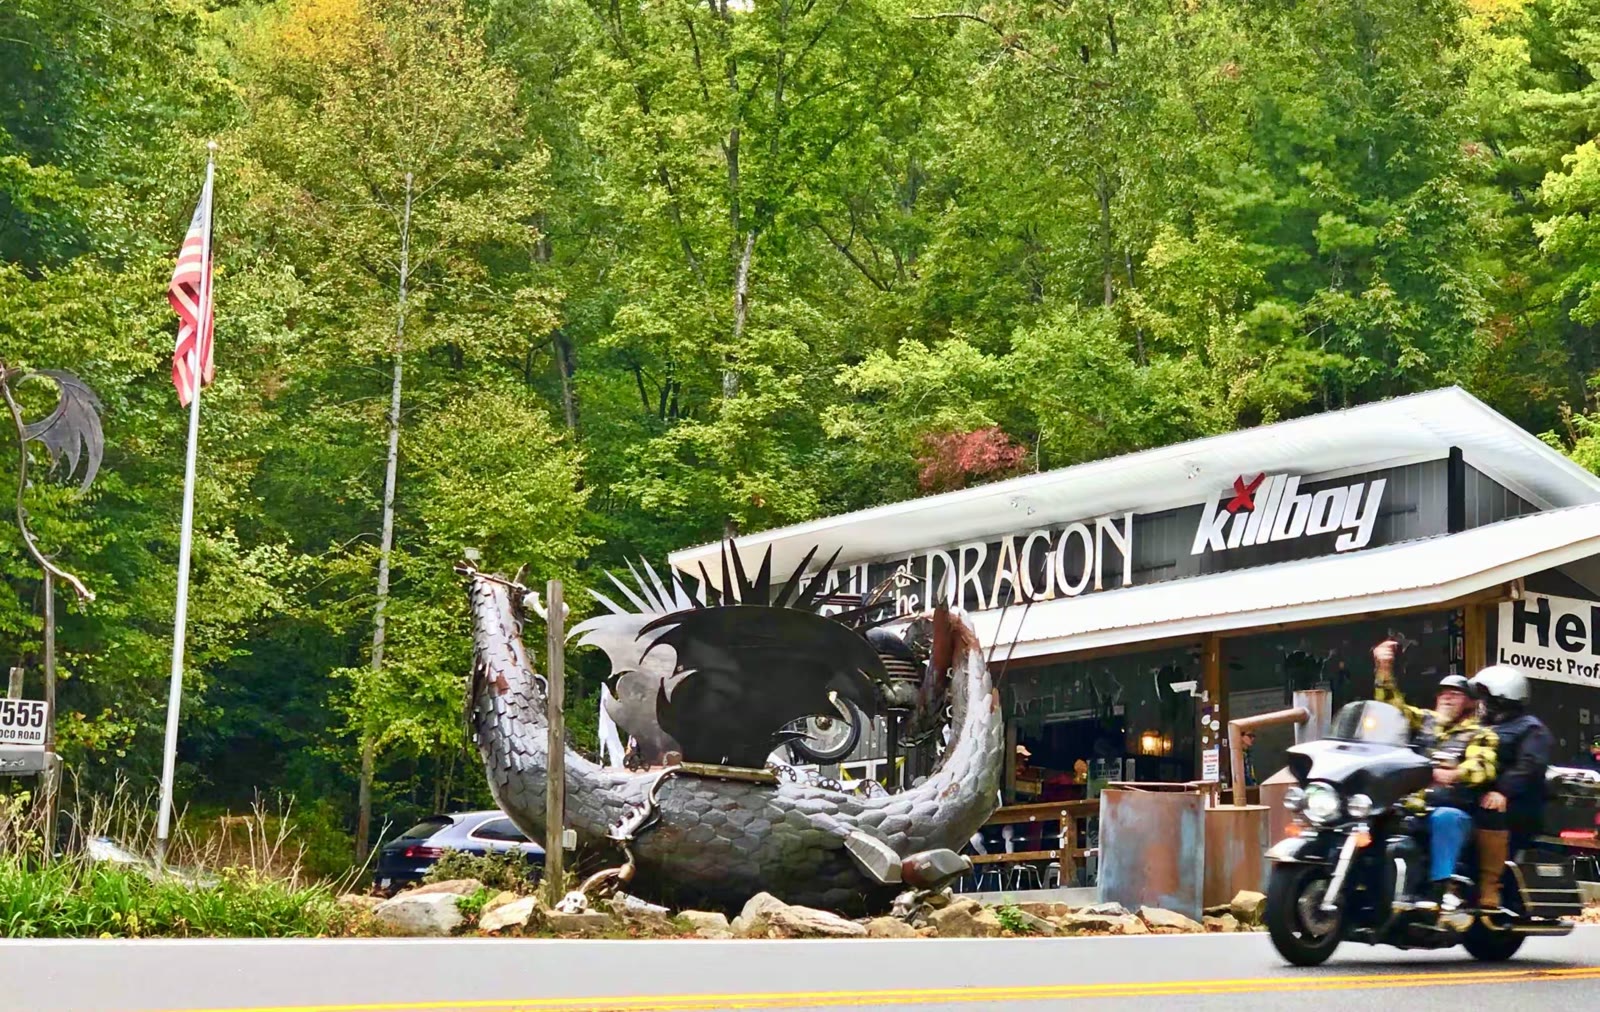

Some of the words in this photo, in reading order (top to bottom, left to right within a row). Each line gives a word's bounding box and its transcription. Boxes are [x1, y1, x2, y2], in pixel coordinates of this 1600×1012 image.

[1190, 472, 1387, 555] killboy
[895, 553, 916, 588] of
[924, 512, 1134, 613] DRAGON
[1500, 648, 1562, 672] Lowest
[1566, 658, 1600, 679] Prof
[0, 701, 43, 728] 555
[18, 731, 41, 740] ROAD
